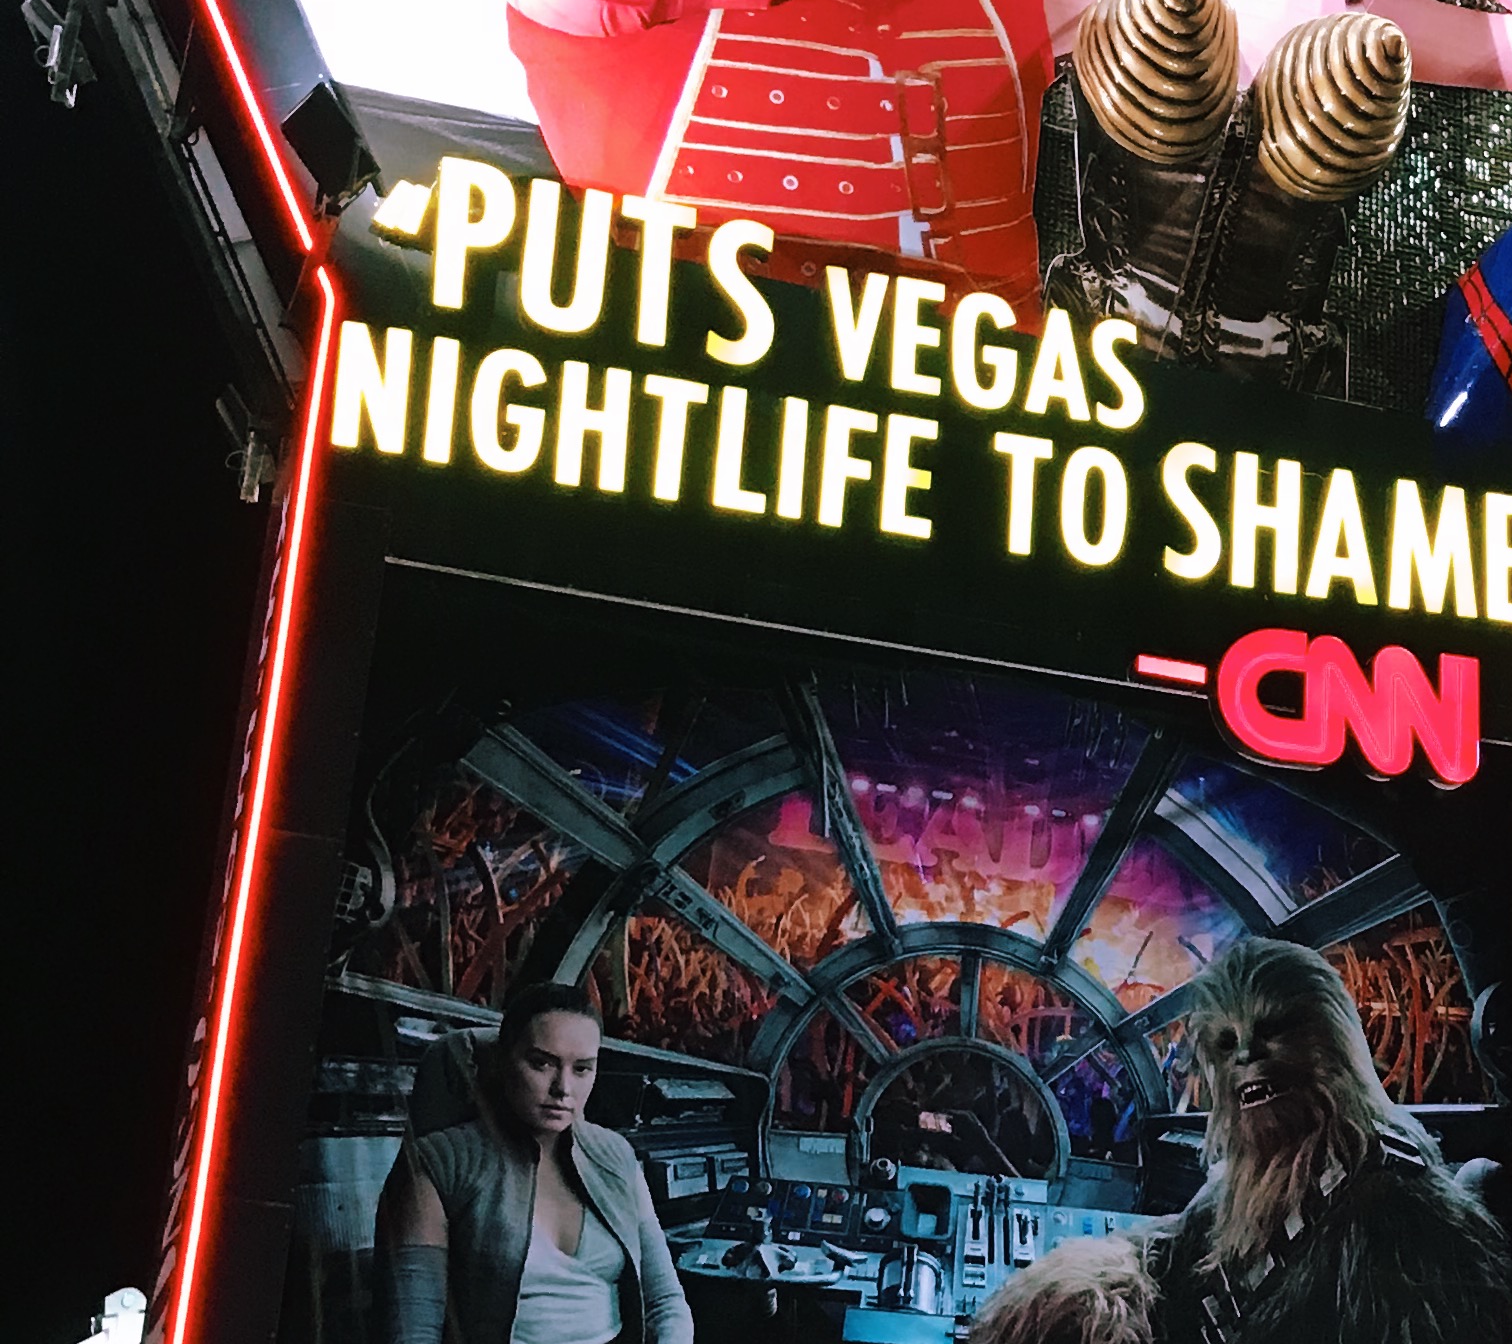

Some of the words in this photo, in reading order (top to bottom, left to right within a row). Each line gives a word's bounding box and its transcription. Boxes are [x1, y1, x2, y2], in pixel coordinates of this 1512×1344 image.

[331, 319, 940, 541] NIGHTLIFE
[996, 431, 1129, 568] TO
[826, 265, 1148, 431] VEGAS
